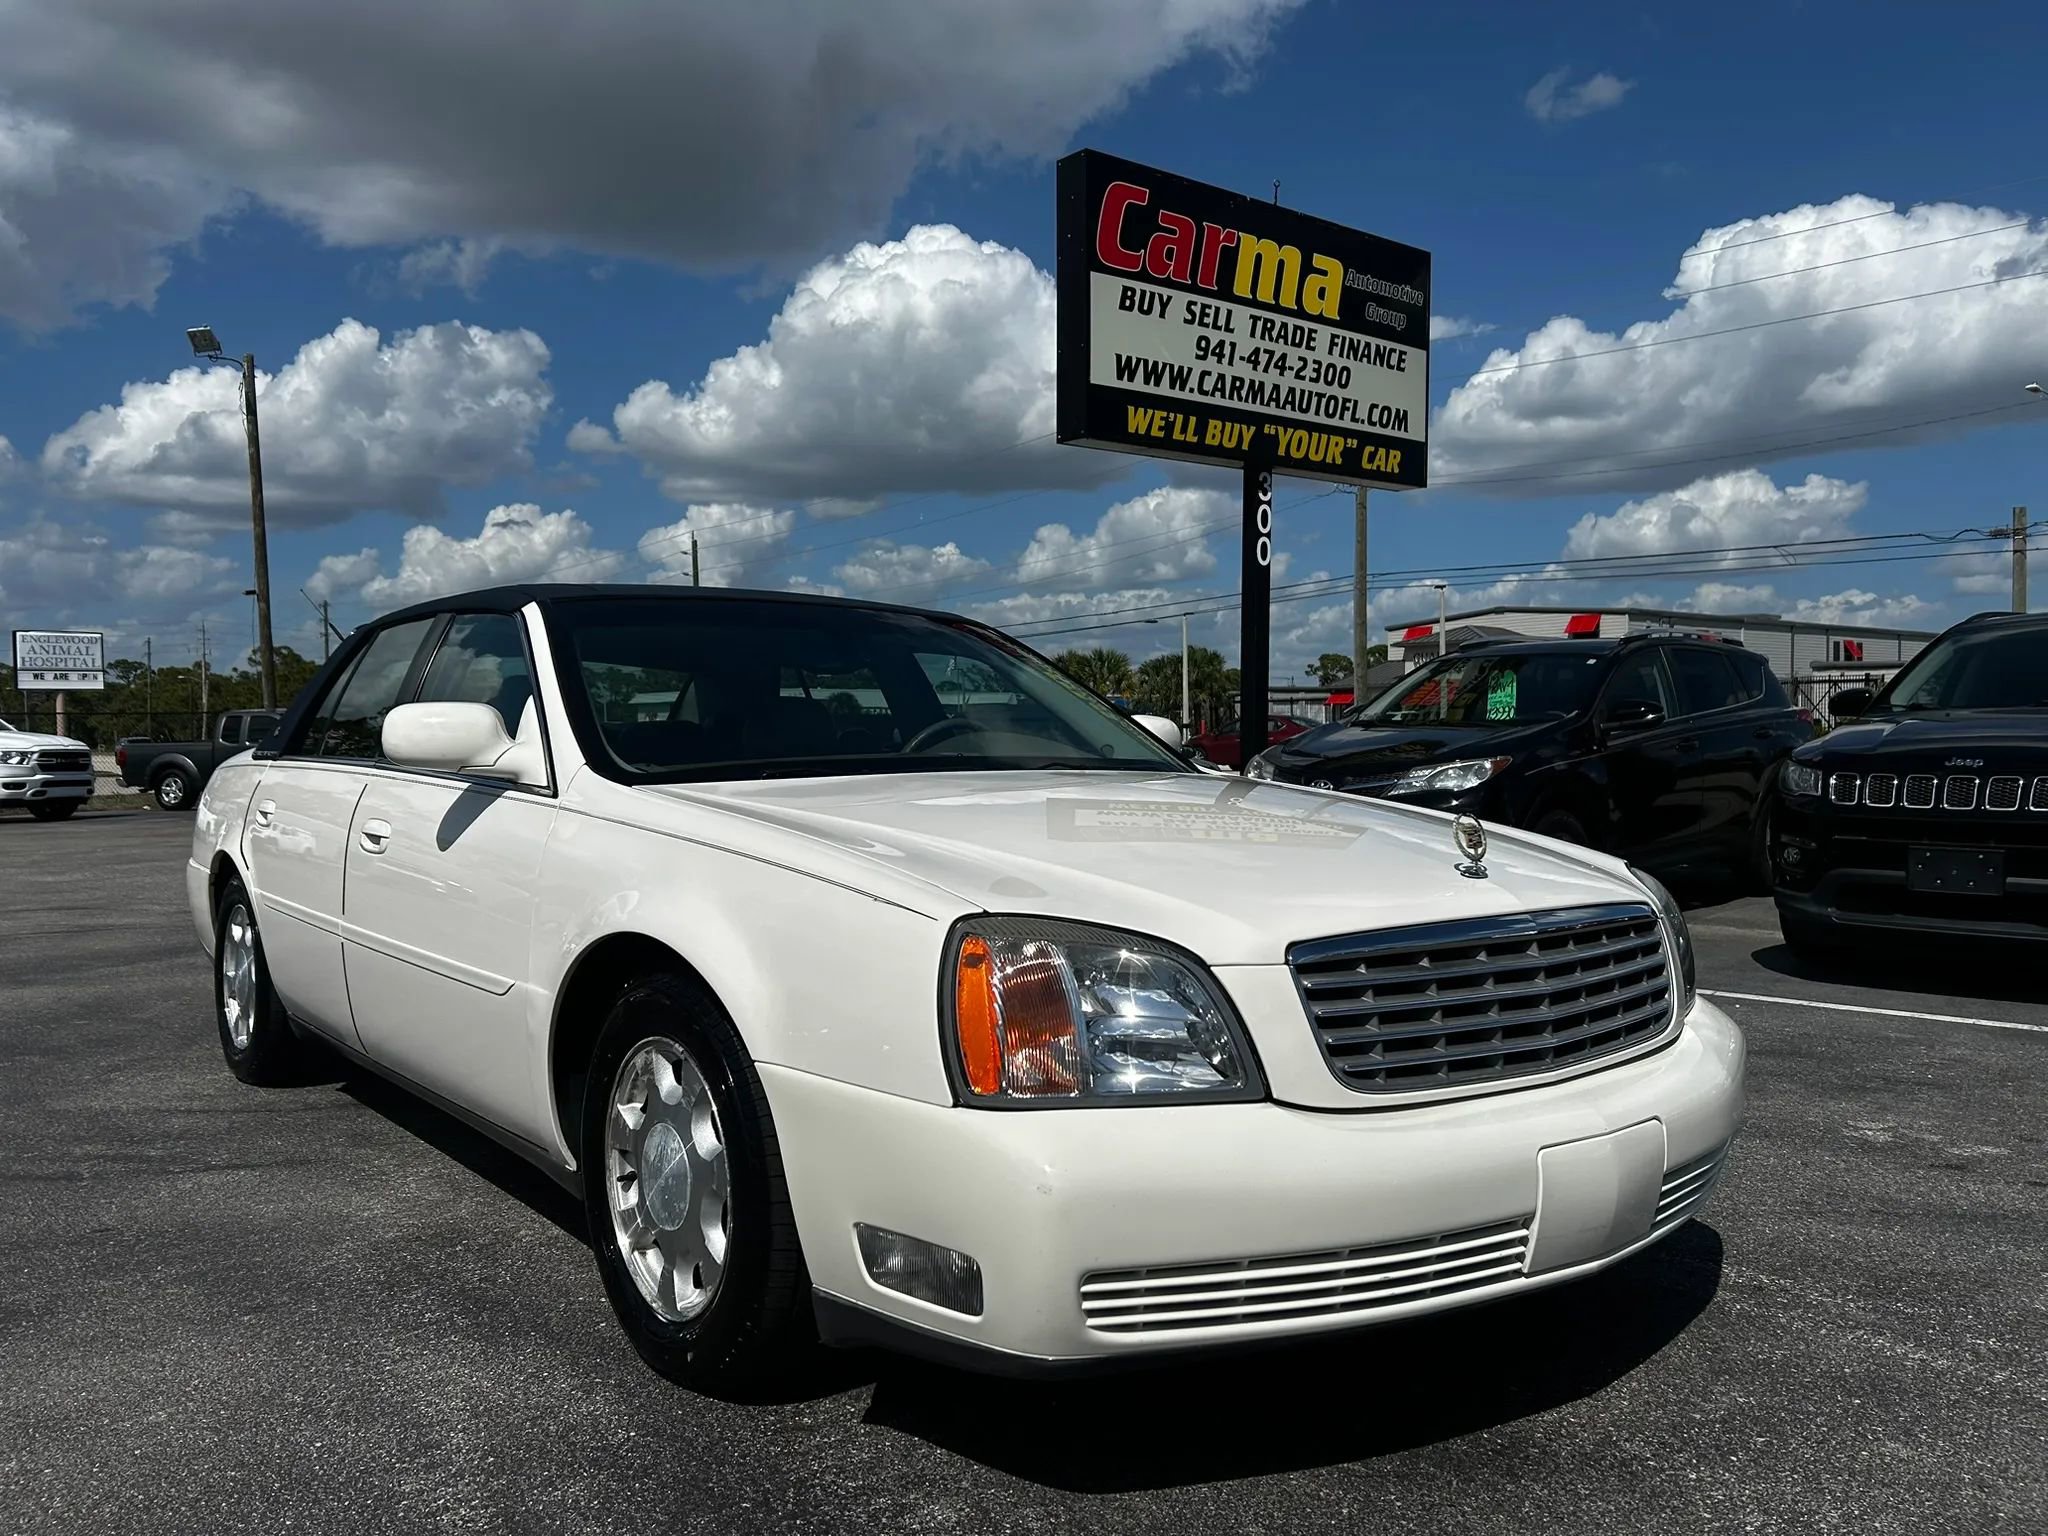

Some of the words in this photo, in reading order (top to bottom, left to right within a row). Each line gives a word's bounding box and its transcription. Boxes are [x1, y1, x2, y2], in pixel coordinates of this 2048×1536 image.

[1096, 181, 1344, 320] Carma
[1345, 268, 1424, 306] Automotive
[1118, 284, 1173, 320] BUY
[1183, 300, 1235, 334] SELL
[1248, 313, 1318, 352] TRADE
[1327, 332, 1408, 373] FINANCE
[1365, 302, 1407, 331] Group
[1194, 335, 1352, 390] 941-474-2300
[1114, 352, 1409, 434] WWW.CARMAAUTOFL.COM
[1127, 405, 1199, 443] WE'LL
[1204, 418, 1256, 451] BUY
[1361, 445, 1402, 473] CAR
[1256, 471, 1272, 566] 300
[21, 634, 99, 645] ENGLEWOOD
[26, 644, 95, 657] ANIMAL
[20, 656, 100, 668] HOSPITAL
[32, 672, 46, 681] WE
[53, 672, 70, 681] ARE
[77, 672, 99, 681] OPN
[1944, 756, 1984, 768] Jeep
